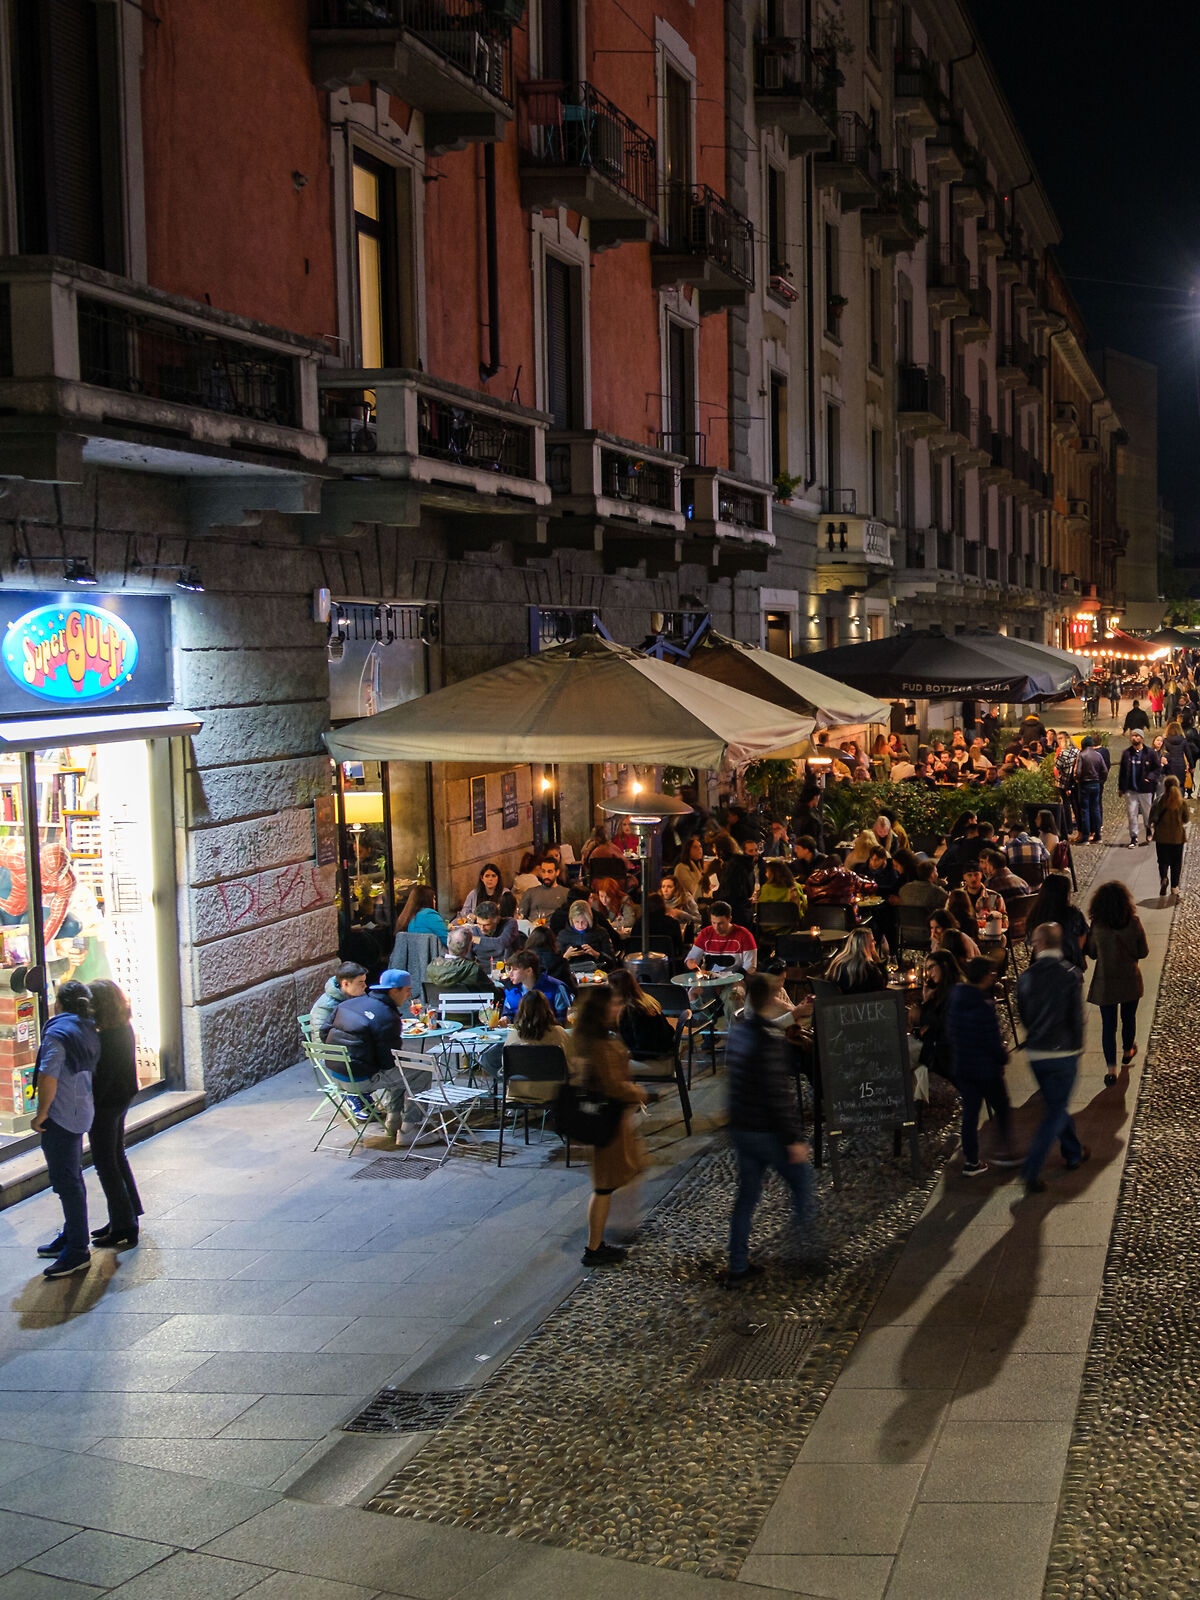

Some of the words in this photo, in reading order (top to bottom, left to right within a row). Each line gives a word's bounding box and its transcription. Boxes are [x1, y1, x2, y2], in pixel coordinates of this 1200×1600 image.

[23, 630, 66, 684] Super
[902, 682, 923, 692] FUD
[839, 1001, 888, 1025] RIVER
